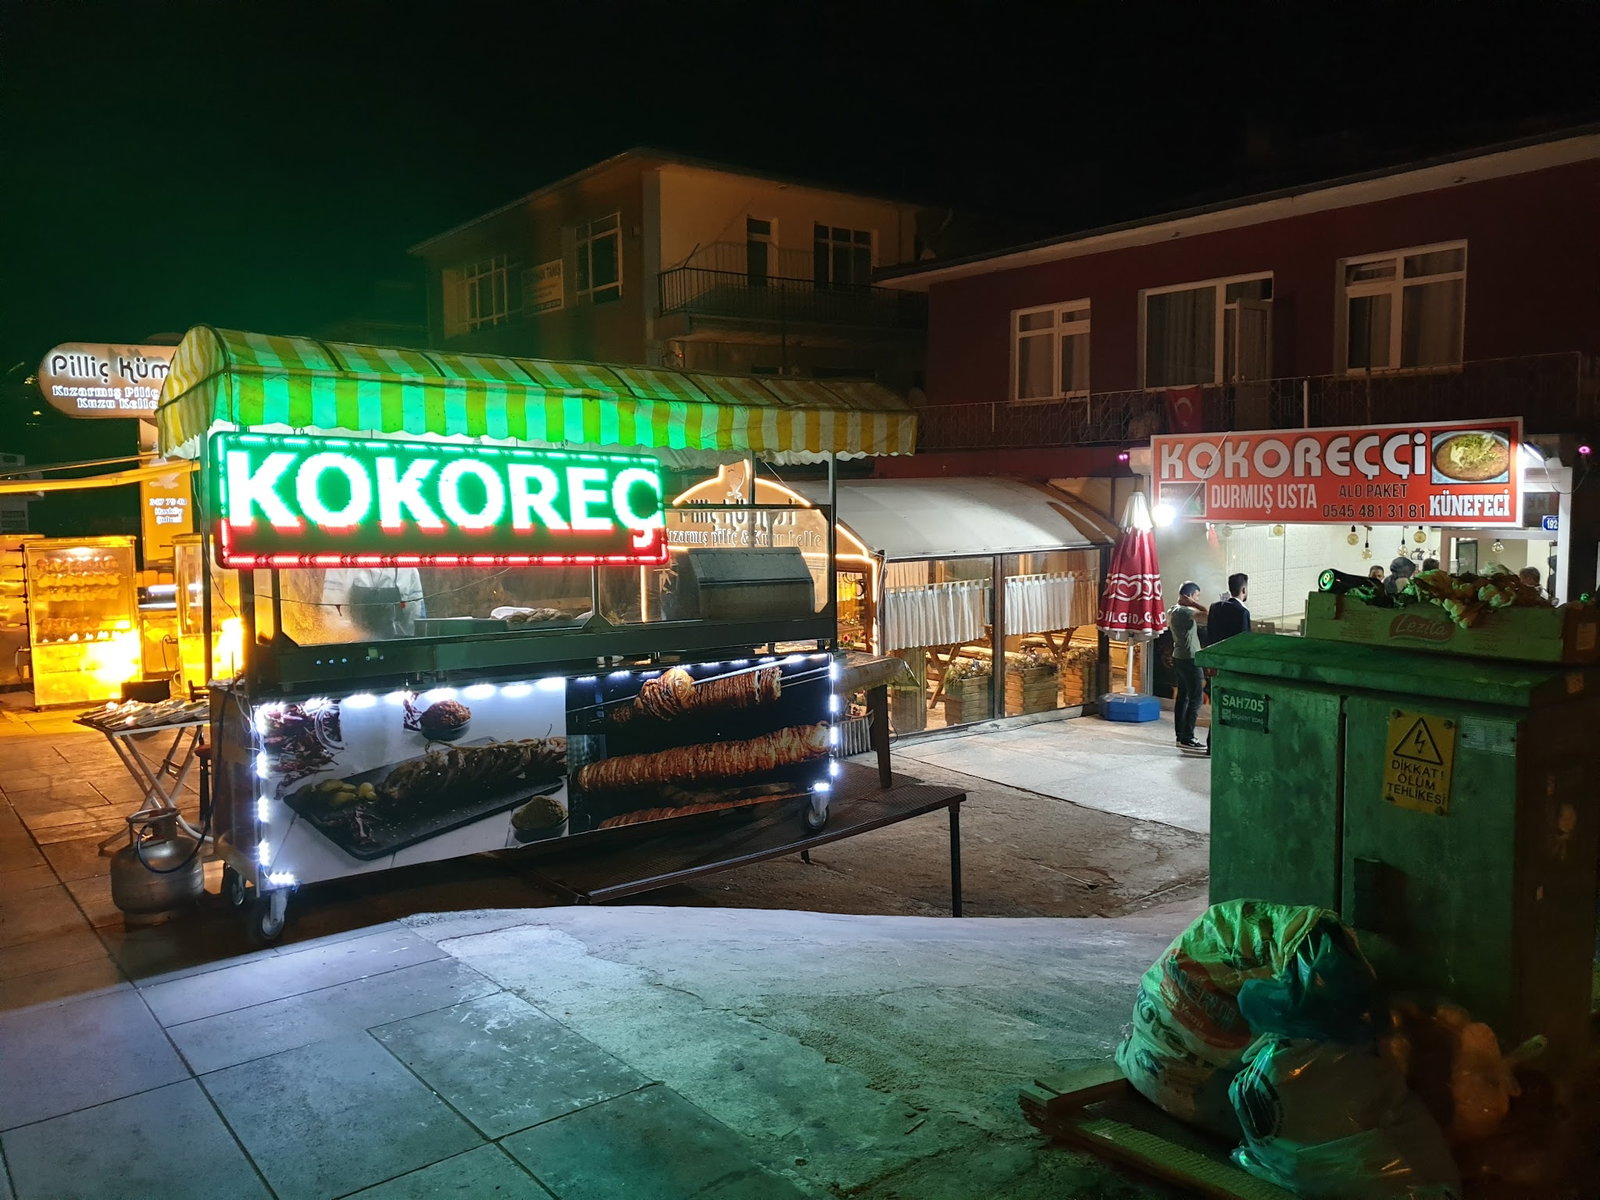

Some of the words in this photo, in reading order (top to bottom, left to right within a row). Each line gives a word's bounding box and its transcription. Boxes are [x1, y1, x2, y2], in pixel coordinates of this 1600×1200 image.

[51, 354, 109, 384] Pilliç
[77, 398, 115, 409] Kuzu
[227, 449, 664, 548] KOKOREÇ
[1211, 484, 1274, 514] DURMUŞ
[1277, 483, 1317, 509] USTA
[1339, 484, 1362, 498] ALO
[1366, 483, 1408, 497] PAKET
[1322, 504, 1354, 518] 0545
[1359, 504, 1382, 518] 481
[1387, 504, 1404, 518] 31
[1409, 504, 1426, 518] 81
[1429, 489, 1511, 517] KÜNEFECİ
[1395, 614, 1447, 635] Lezita
